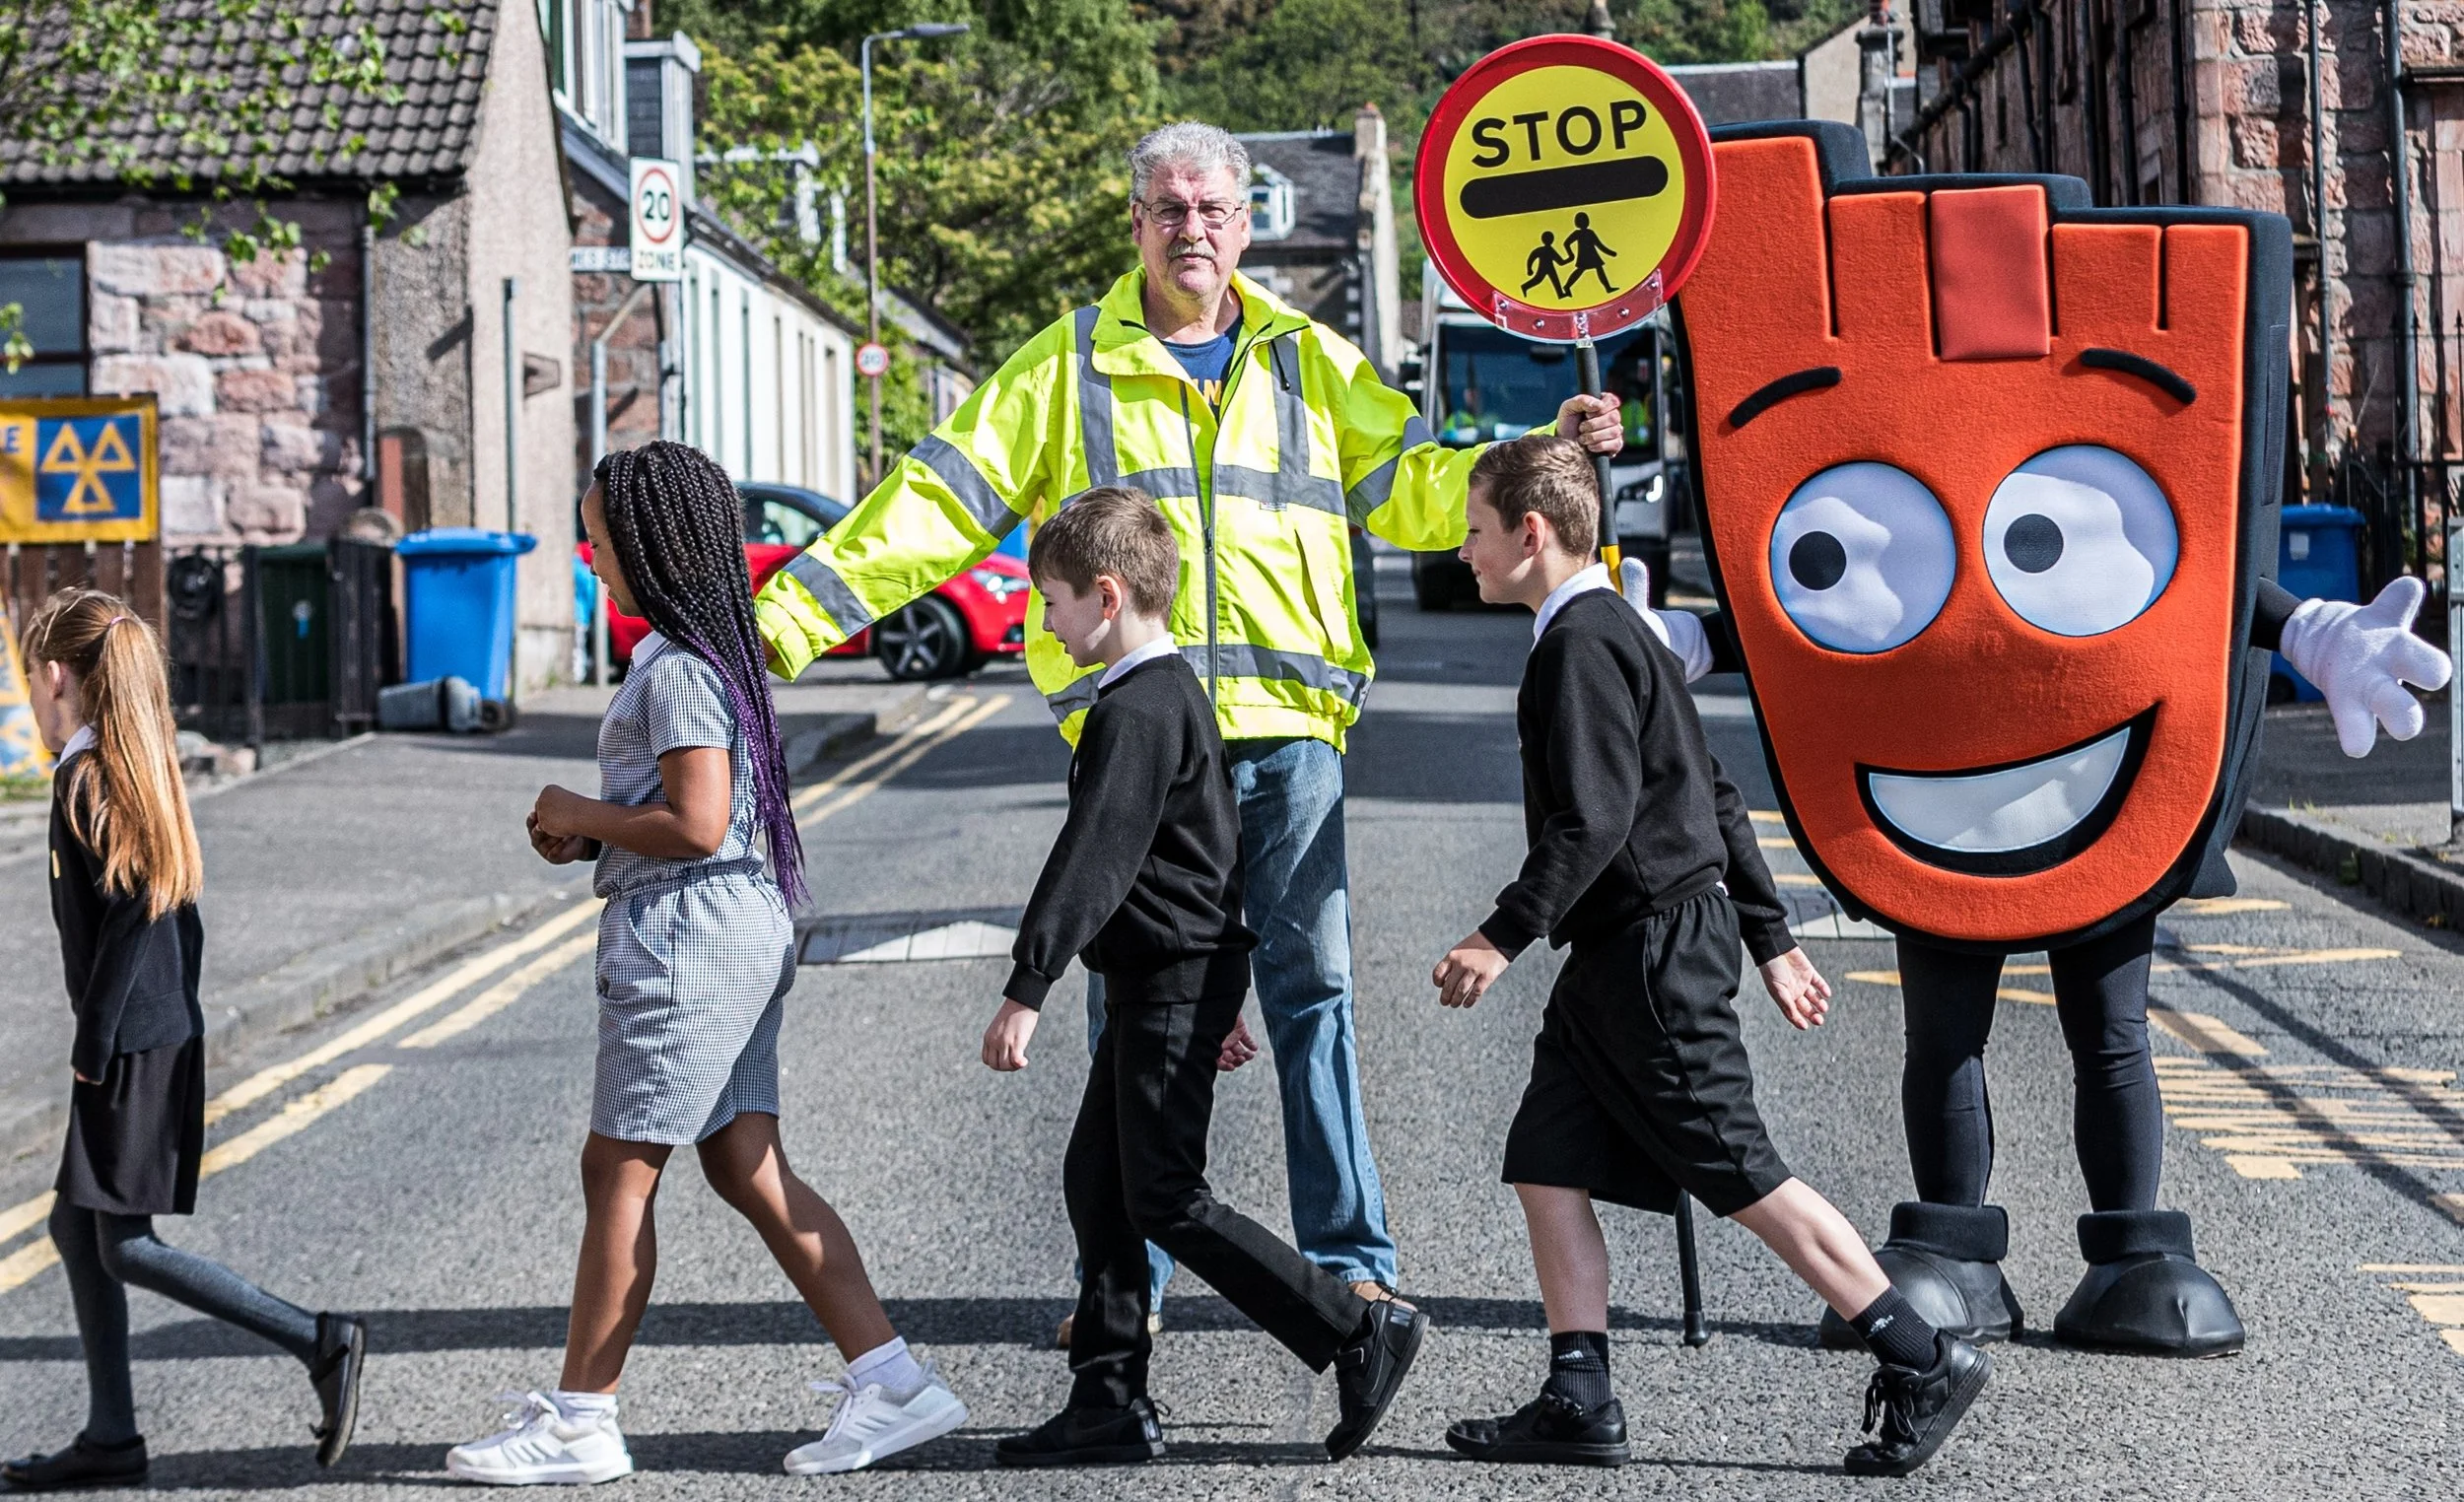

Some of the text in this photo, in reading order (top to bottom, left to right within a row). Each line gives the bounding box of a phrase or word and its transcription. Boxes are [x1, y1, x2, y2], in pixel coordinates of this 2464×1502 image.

[1472, 100, 1647, 168] STOP
[642, 190, 670, 221] 20
[639, 250, 675, 272] ZONE
